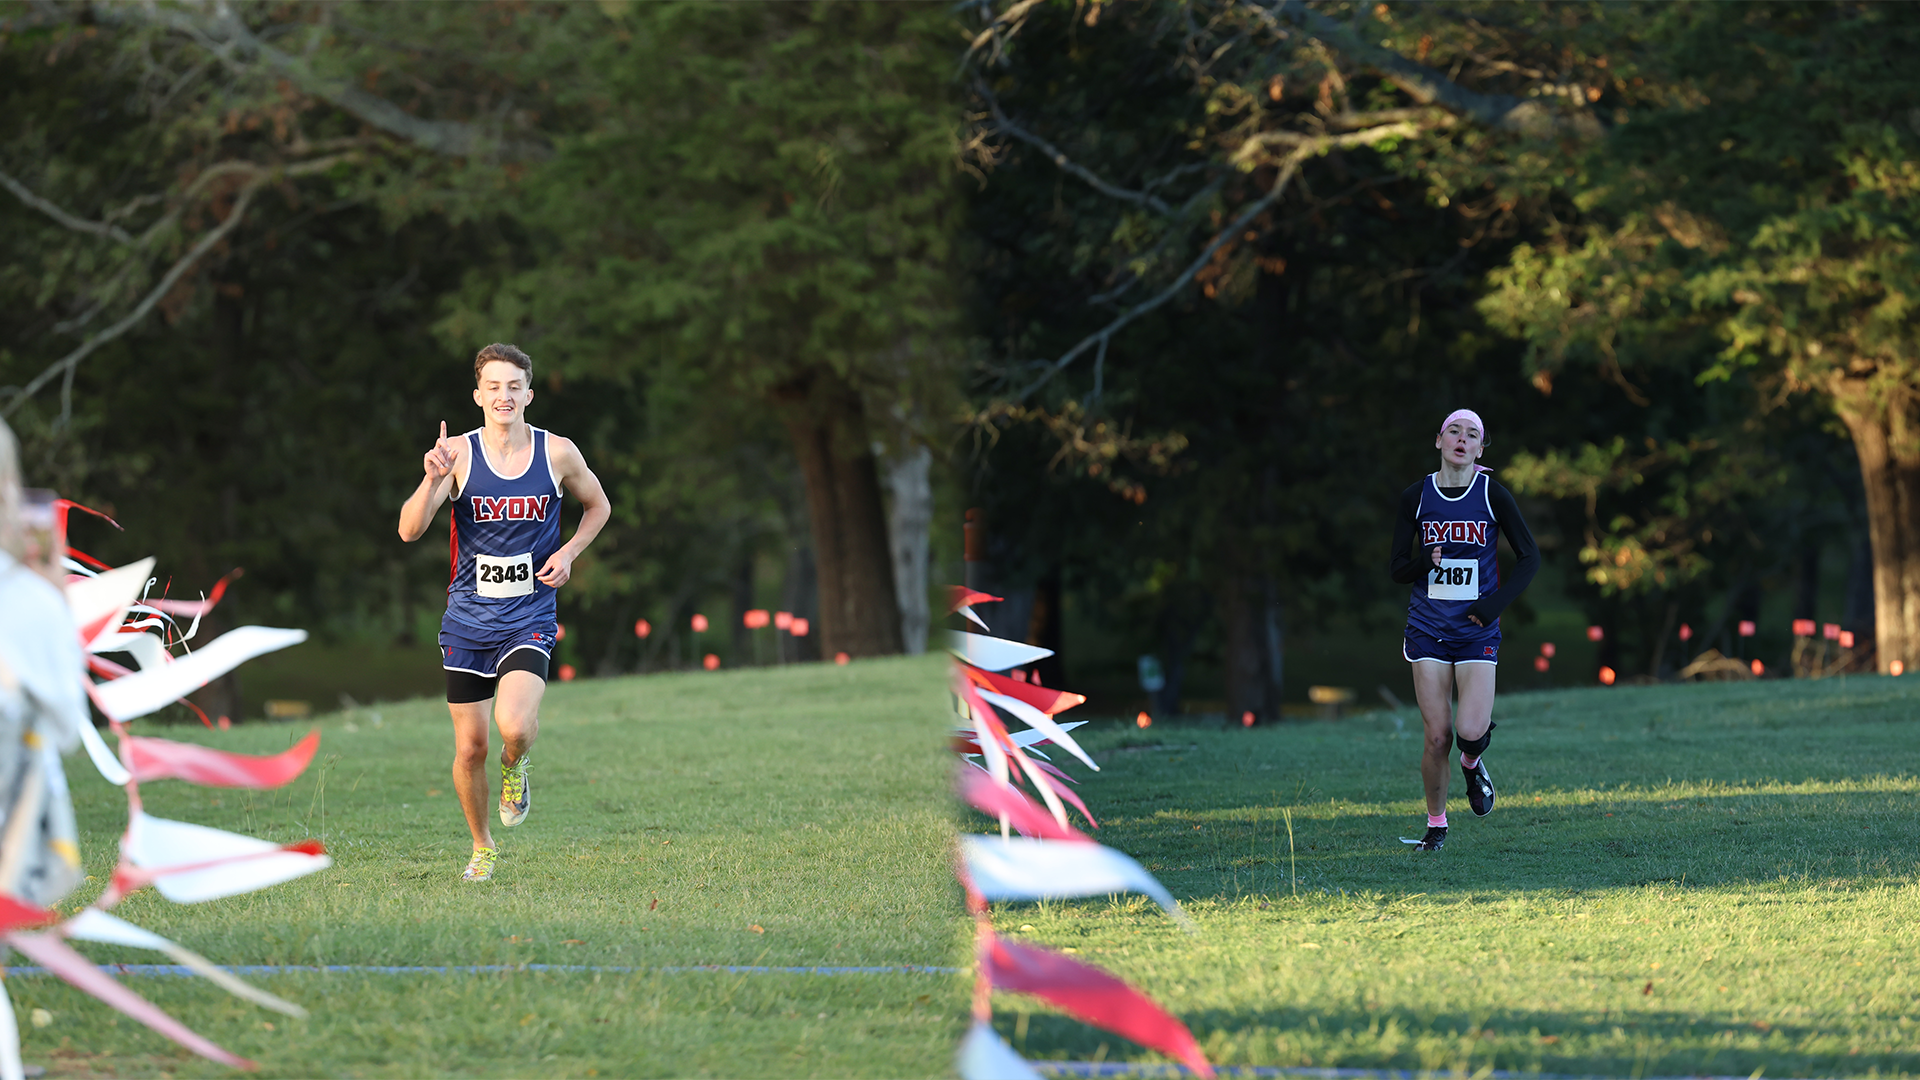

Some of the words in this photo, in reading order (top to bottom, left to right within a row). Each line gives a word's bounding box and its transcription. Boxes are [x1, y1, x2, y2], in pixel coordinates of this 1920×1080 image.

[471, 494, 550, 523] LYON
[1422, 521, 1487, 547] LYON
[480, 563, 529, 584] 2343
[1434, 567, 1473, 585] 2187
